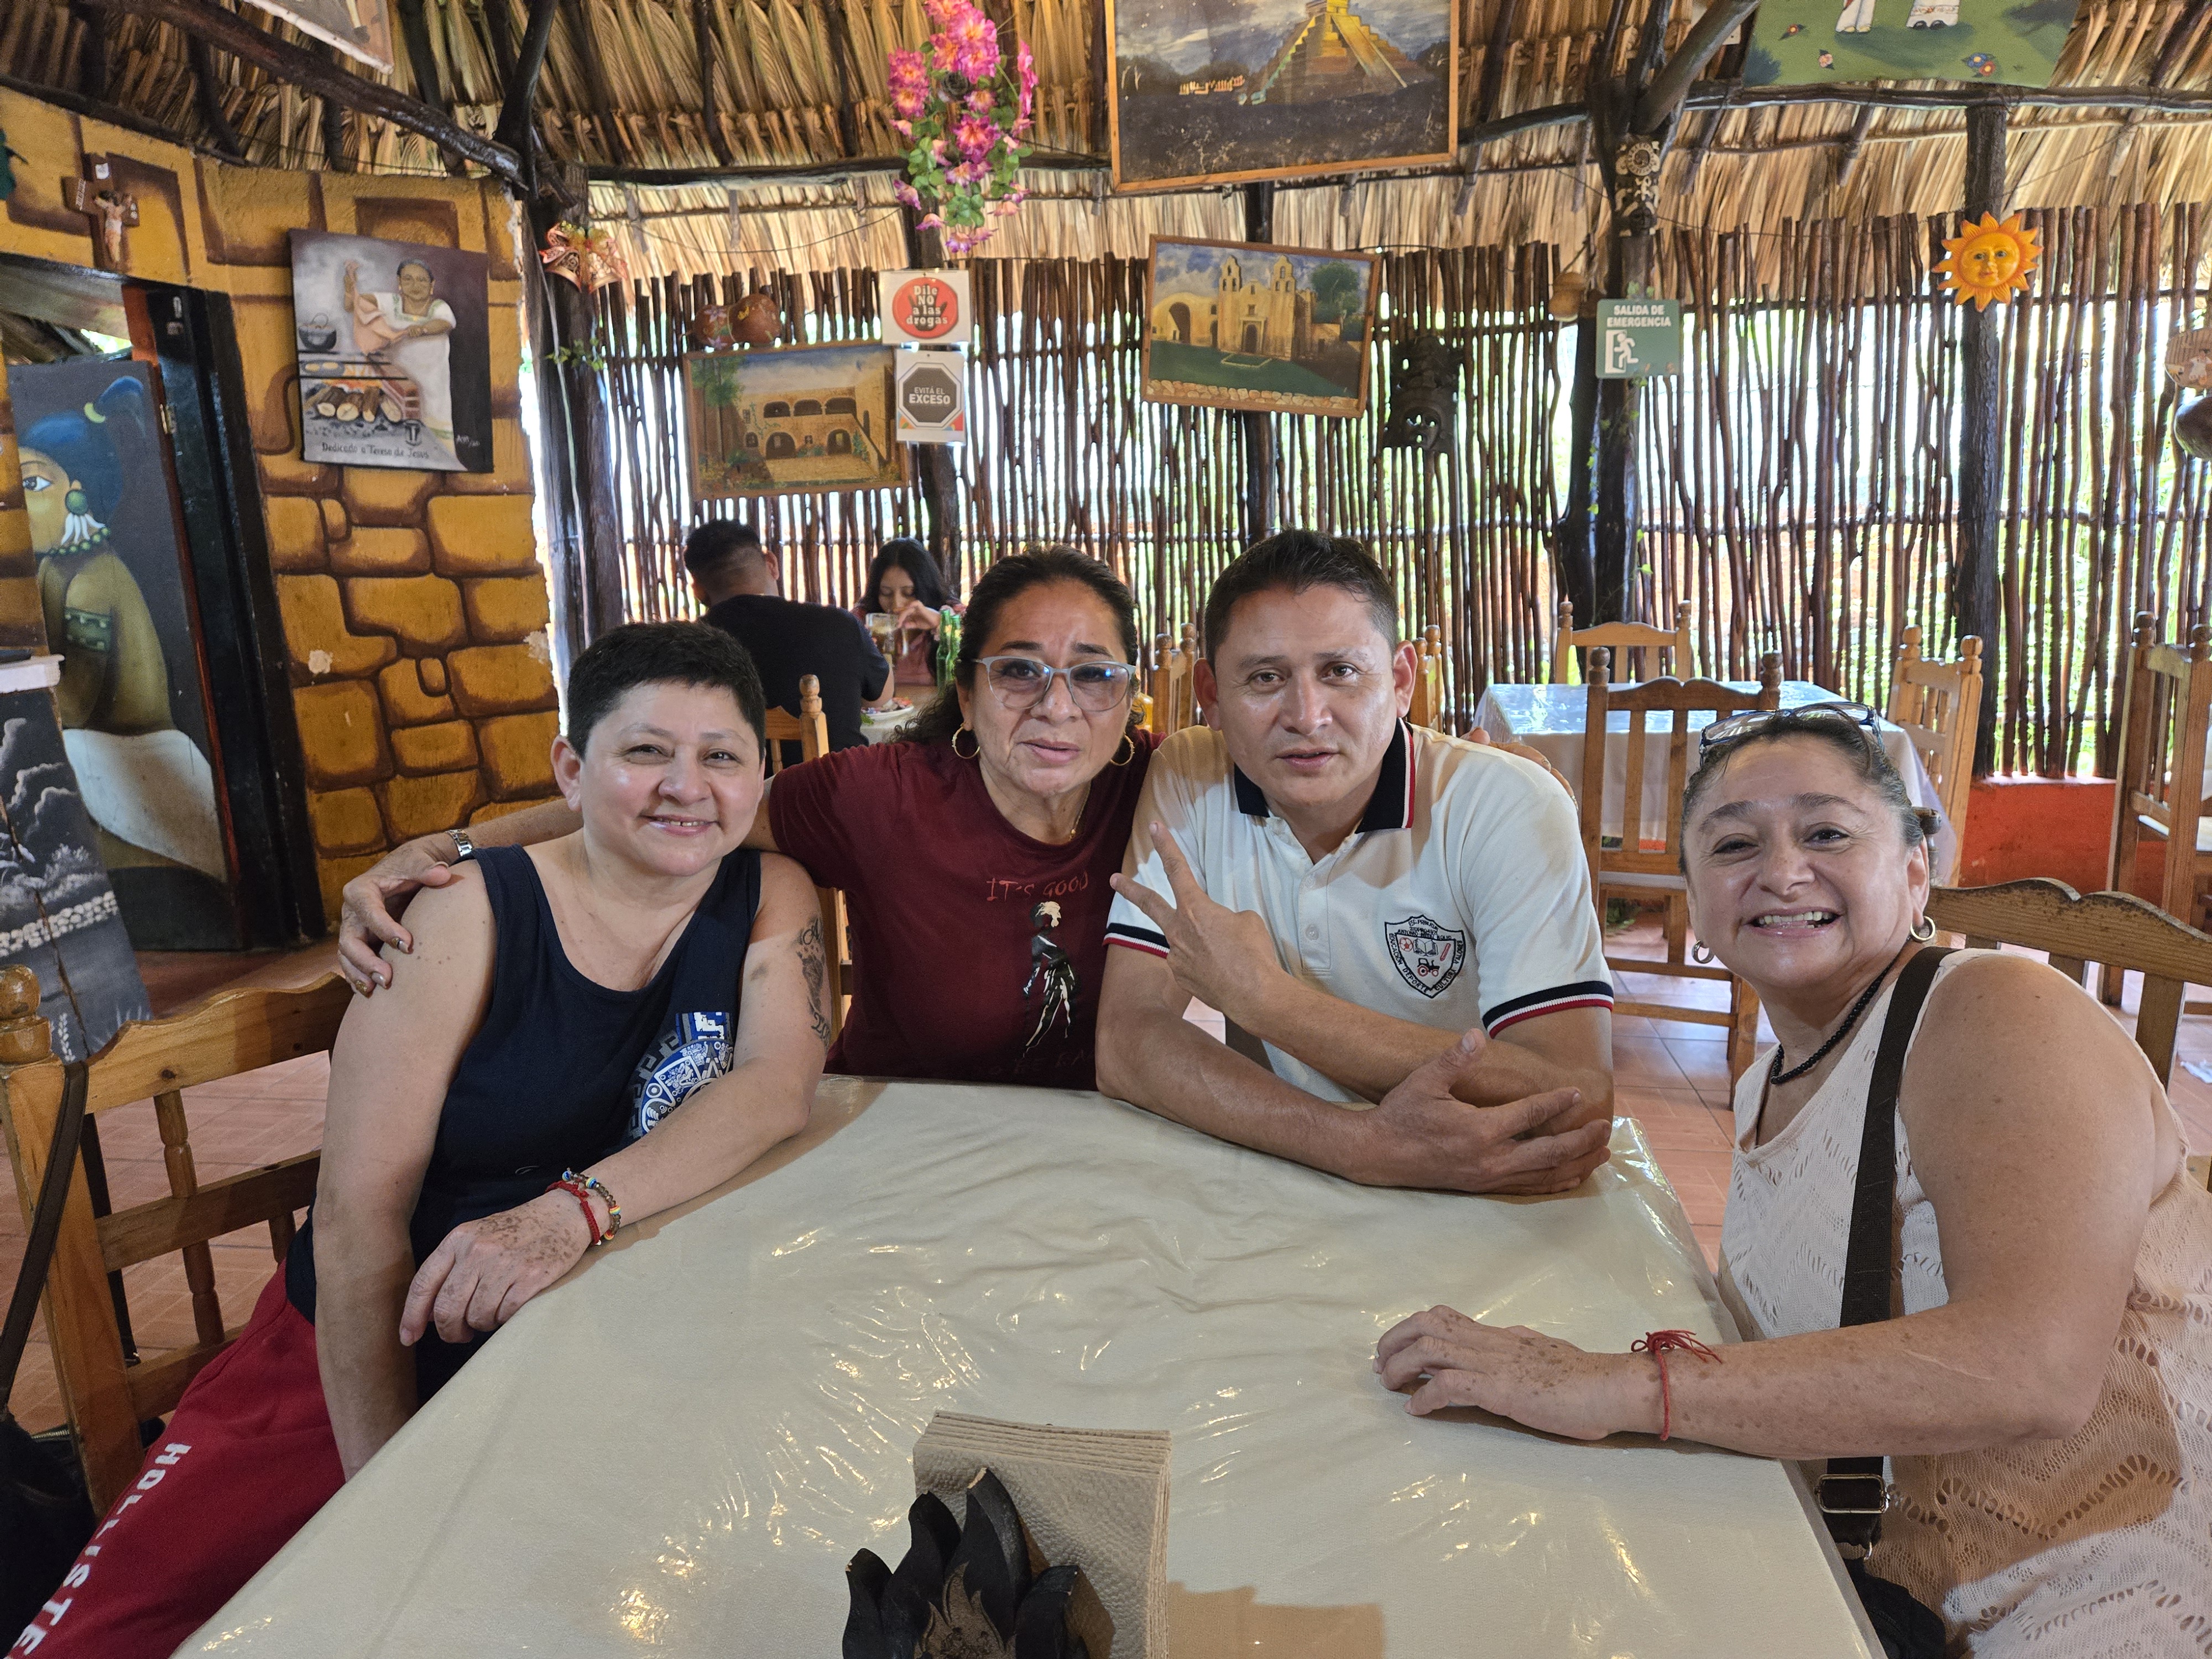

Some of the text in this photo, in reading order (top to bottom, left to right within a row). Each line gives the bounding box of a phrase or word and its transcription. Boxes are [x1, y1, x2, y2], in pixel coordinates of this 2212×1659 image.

[914, 285, 938, 295] Dile
[918, 295, 935, 305] NO
[913, 305, 941, 315] a las
[1614, 305, 1665, 315] SALIDA DE
[906, 315, 948, 327] drogas
[1606, 316, 1671, 327] EMERGENCIA
[909, 393, 951, 404] EXCESO
[1402, 967, 1428, 993] DEPORTE
[1433, 968, 1457, 991] CULTURA
[2, 1442, 192, 1659] HOLLISTE
